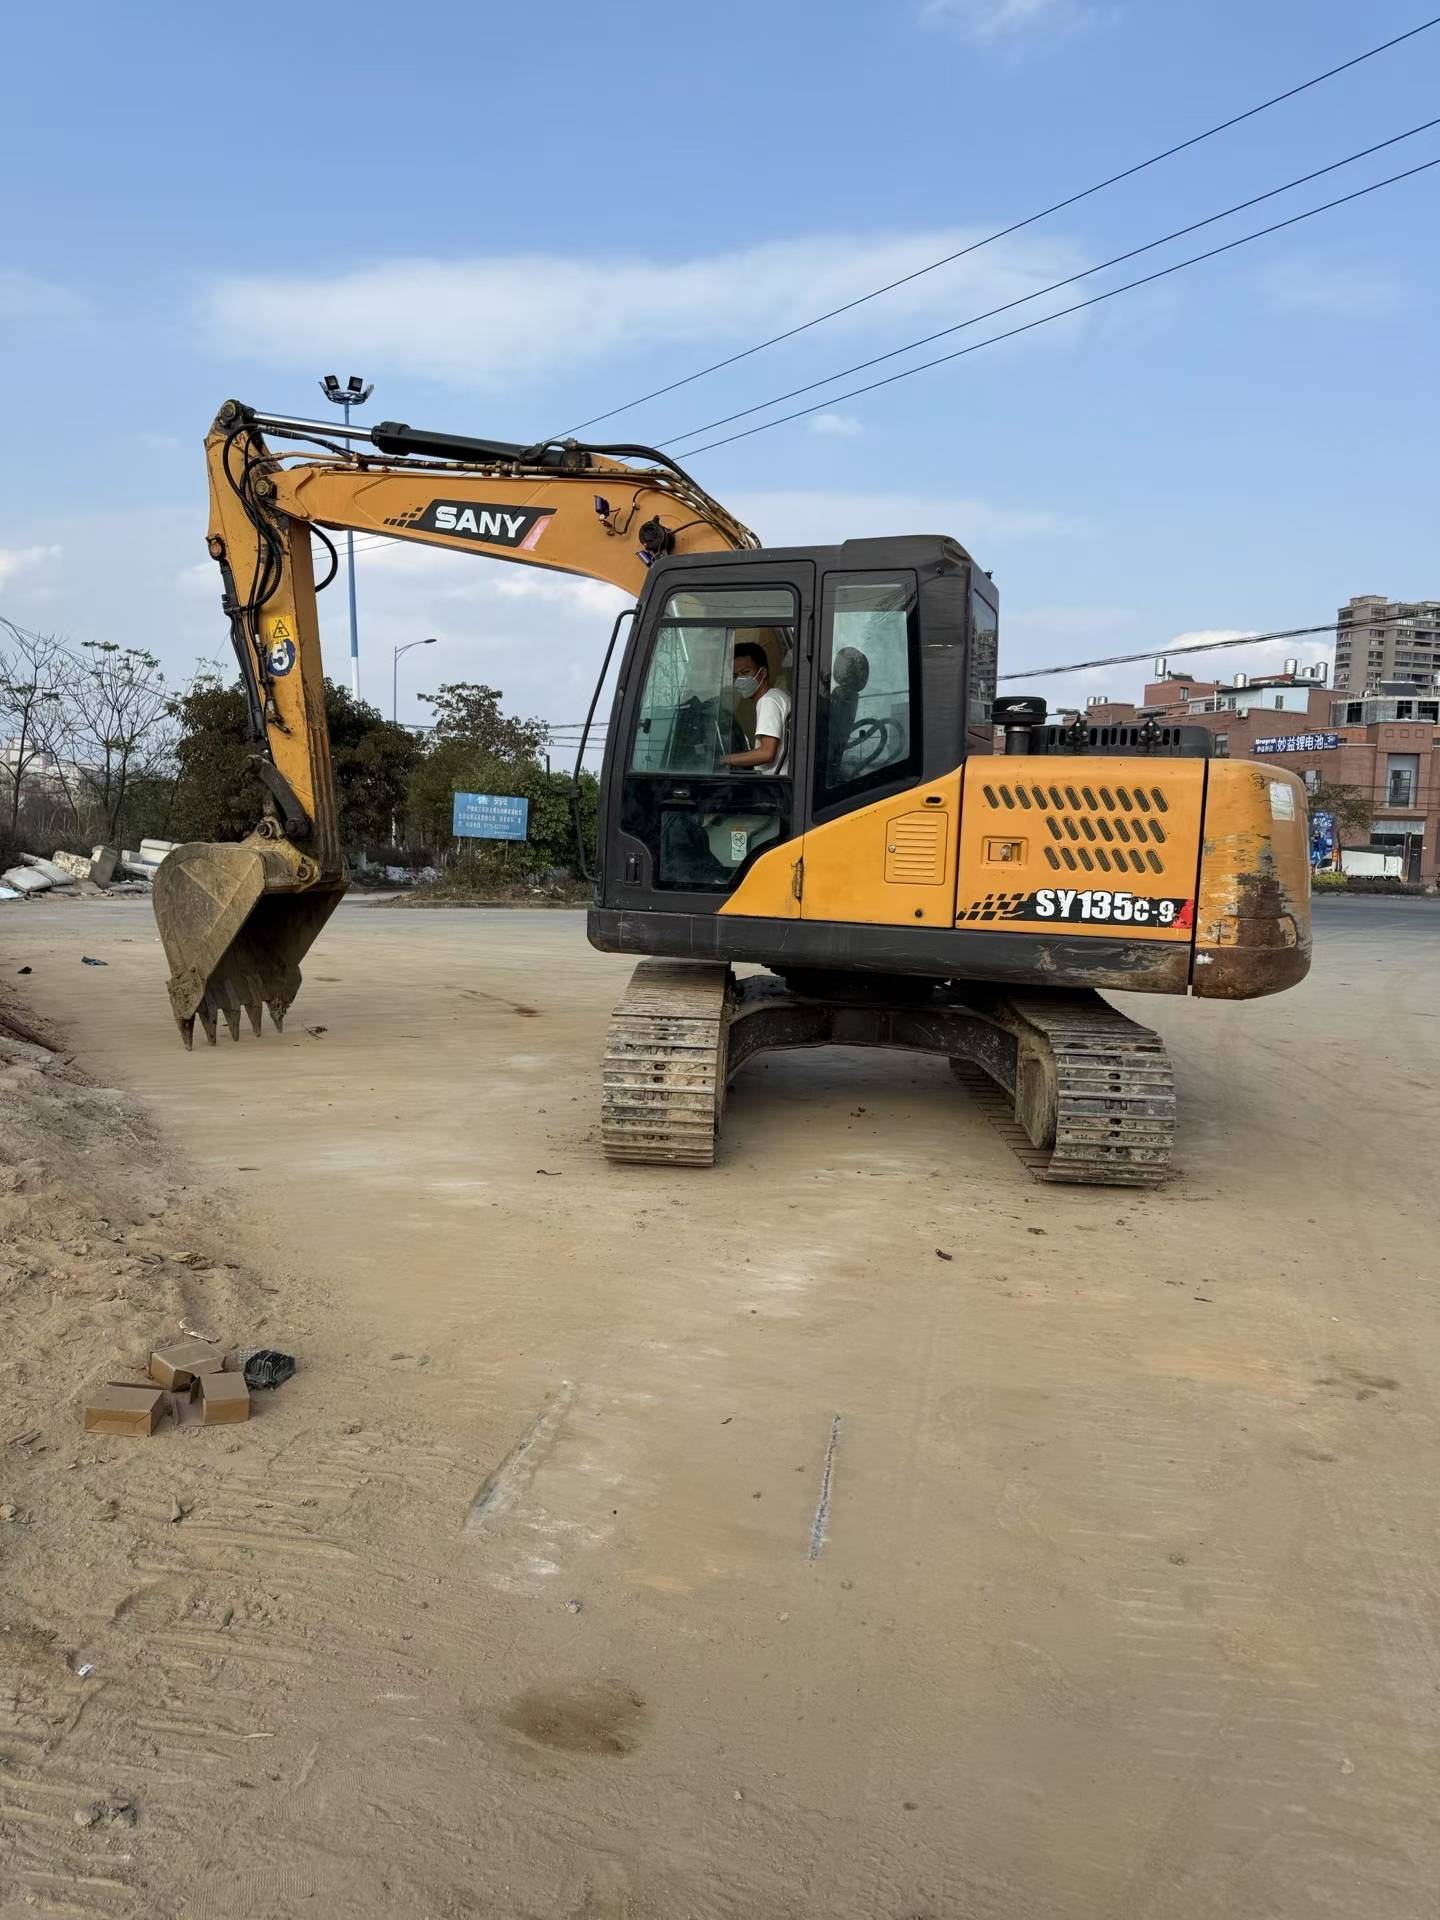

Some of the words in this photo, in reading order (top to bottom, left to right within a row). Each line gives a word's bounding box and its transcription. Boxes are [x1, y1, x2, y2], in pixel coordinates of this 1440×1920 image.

[434, 505, 526, 539] SANY
[1277, 734, 1324, 752] 妙益锂电池
